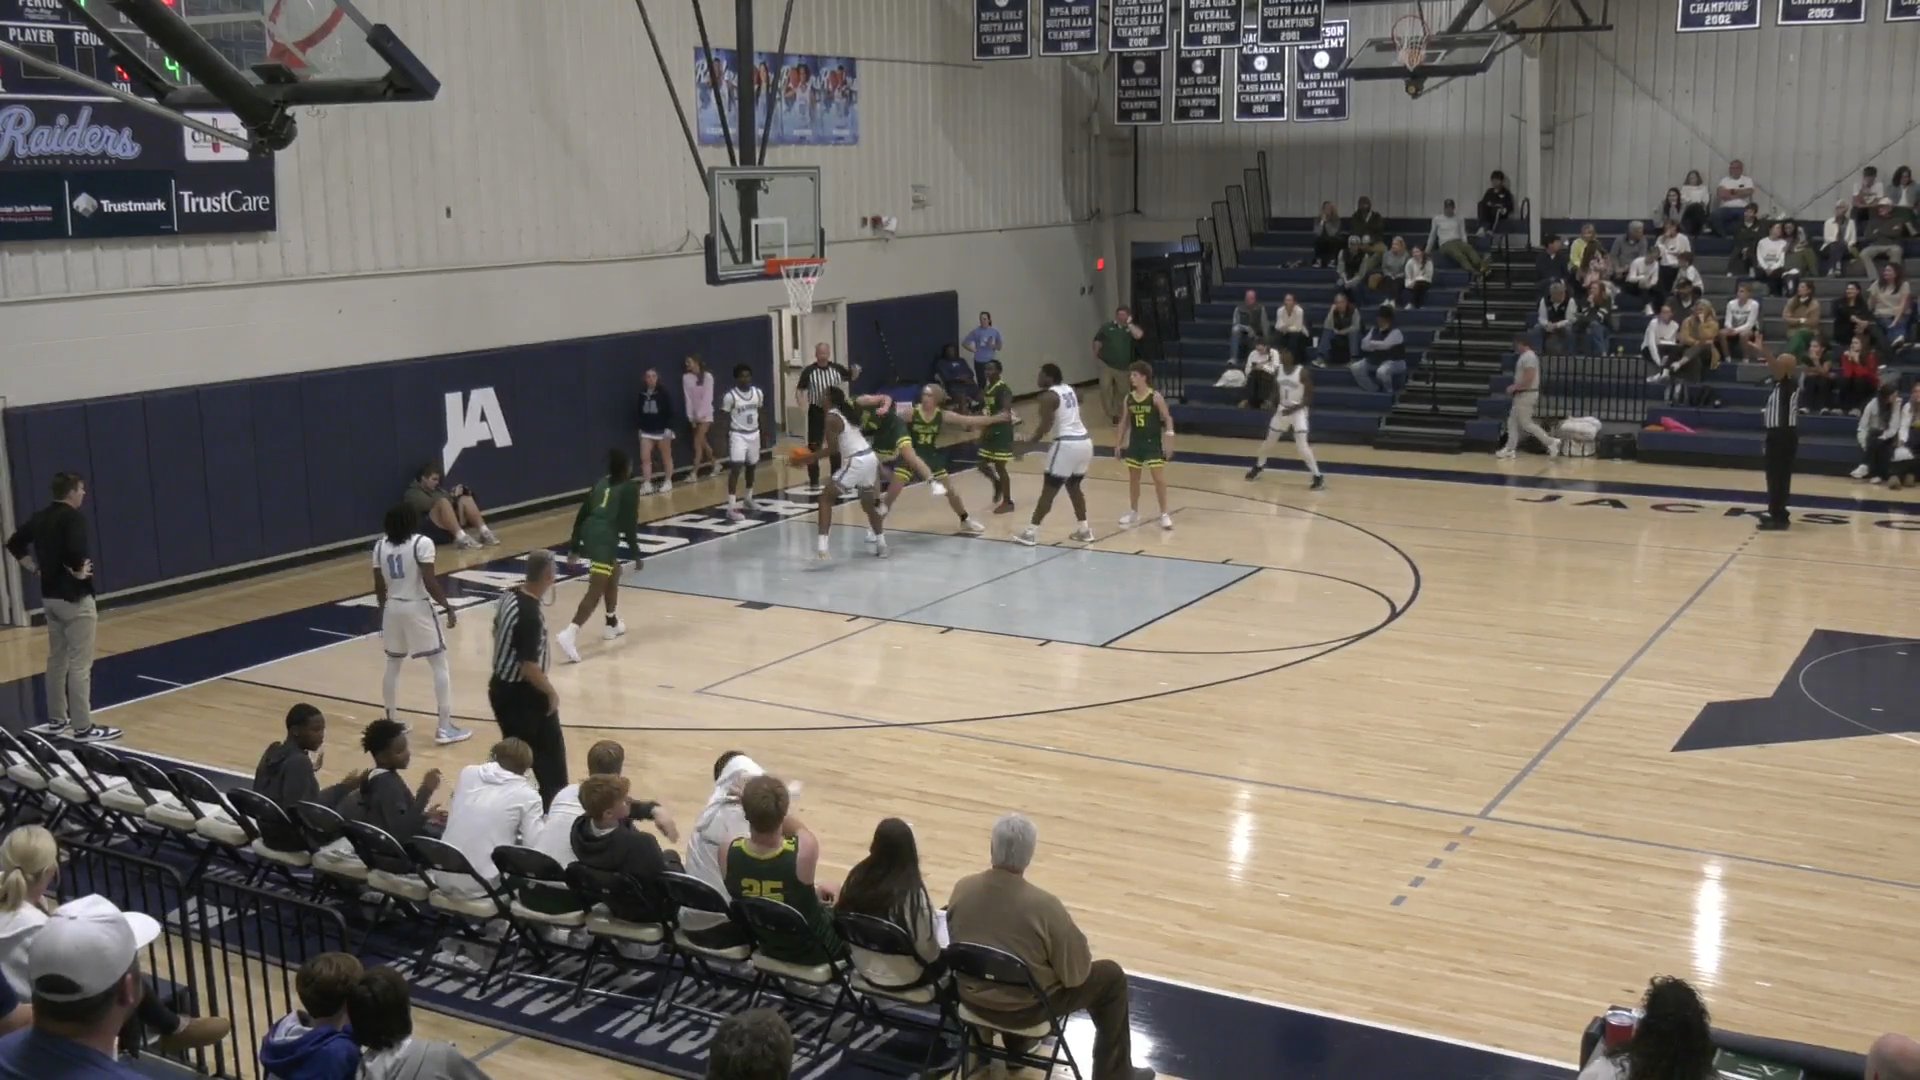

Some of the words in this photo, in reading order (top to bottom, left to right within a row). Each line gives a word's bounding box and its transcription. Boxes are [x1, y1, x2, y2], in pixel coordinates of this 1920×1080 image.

[1263, 7, 1291, 17] SOUTH
[1689, 1, 1750, 14] CHAMPIONS
[1807, 7, 1835, 19] 2003
[1193, 10, 1232, 21] OVERALL
[1704, 13, 1732, 26] 2002
[1189, 22, 1237, 34] CHAMPIONS
[1267, 17, 1315, 29] CHAMPIONS
[9, 27, 55, 44] PLAYER
[74, 31, 104, 46] FOUL
[1117, 26, 1161, 38] CHAMPIONS
[164, 56, 182, 82] 4
[0, 104, 142, 161] Raiders
[100, 200, 167, 213] Trustmark
[179, 190, 270, 213] TrustCare
[1135, 414, 1145, 428] 15
[442, 386, 514, 478] JA
[387, 554, 405, 579] 11
[741, 877, 785, 902] 25
